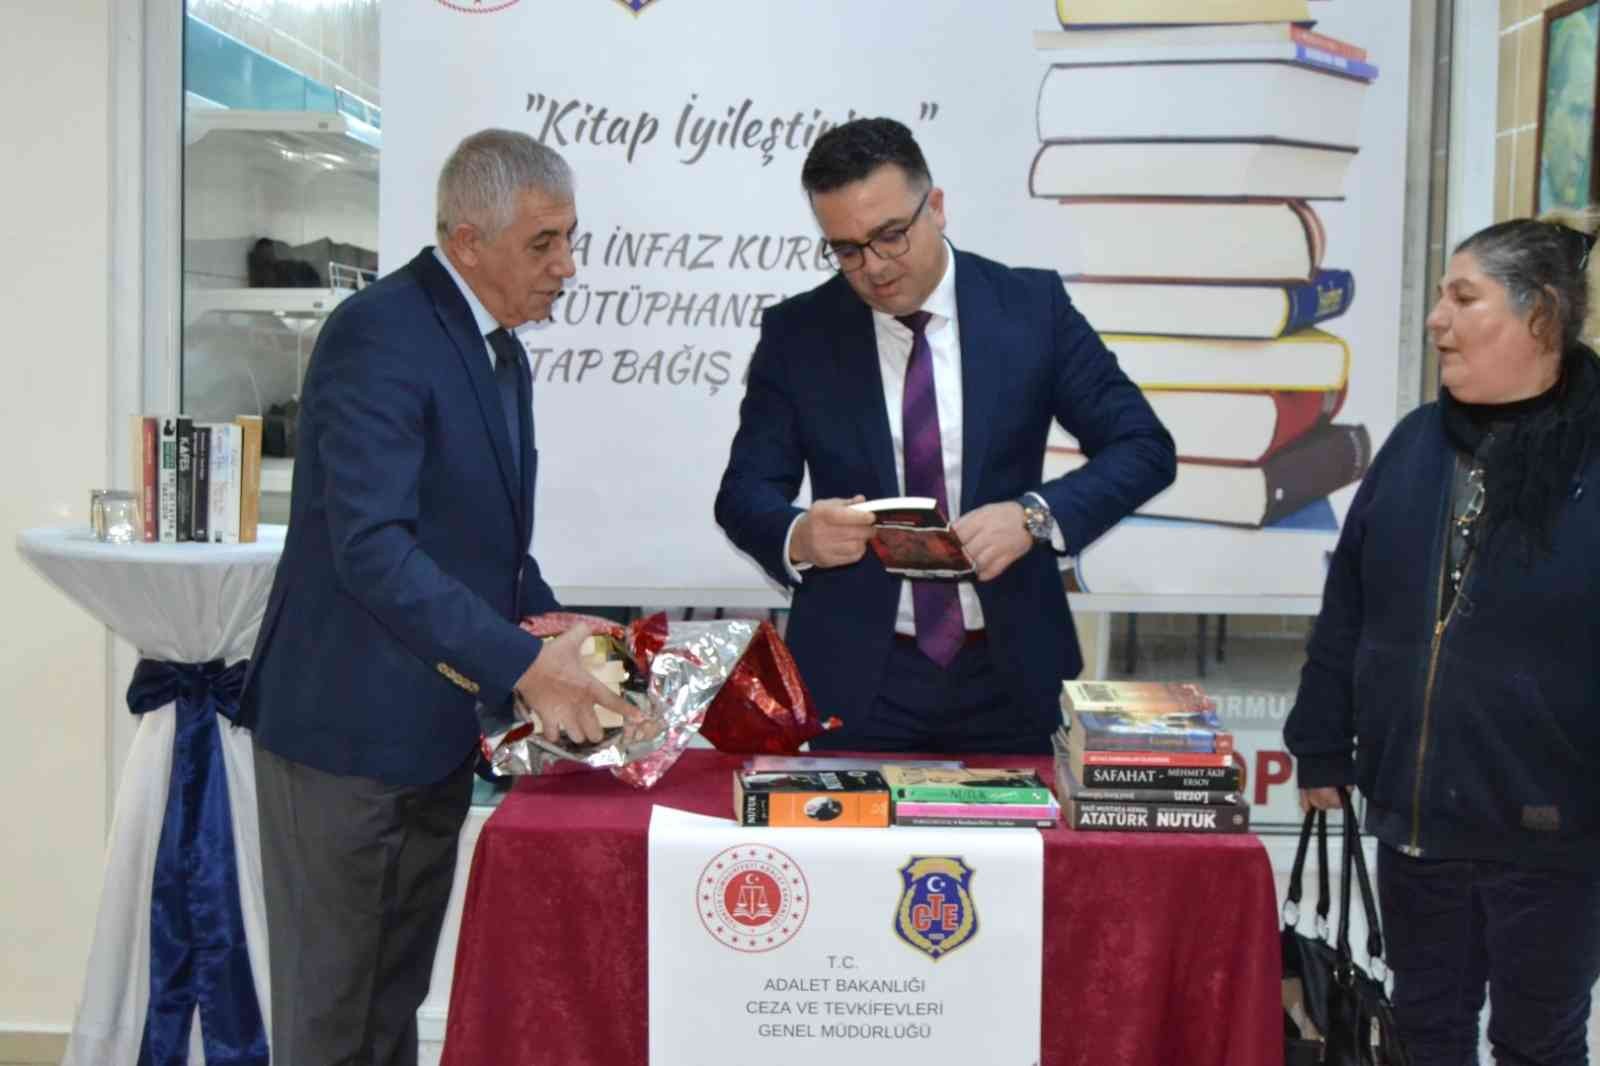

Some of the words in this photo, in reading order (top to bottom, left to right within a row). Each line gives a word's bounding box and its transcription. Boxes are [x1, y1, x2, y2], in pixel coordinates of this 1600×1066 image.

[604, 225, 724, 269] İNFAZ
[541, 284, 786, 328] ÜTÜPHANE
[527, 348, 604, 383] TAP
[611, 344, 732, 396] BAĞIŞ
[179, 437, 191, 471] KAFES
[1093, 770, 1157, 782] SAFAHAT
[1080, 812, 1149, 827] ATATÜRK
[1156, 812, 1217, 829] NUTUK
[827, 955, 859, 970] T.C.
[764, 977, 832, 993] ADALET
[836, 976, 926, 993] BAKANLIĞI
[746, 1001, 791, 1015] CEZA
[797, 1001, 819, 1015] VE
[825, 999, 945, 1017] TEVKİFEVLERİ
[758, 1023, 816, 1038] GENEL
[821, 1021, 932, 1040] MÜDÜRLÜĞÜ
